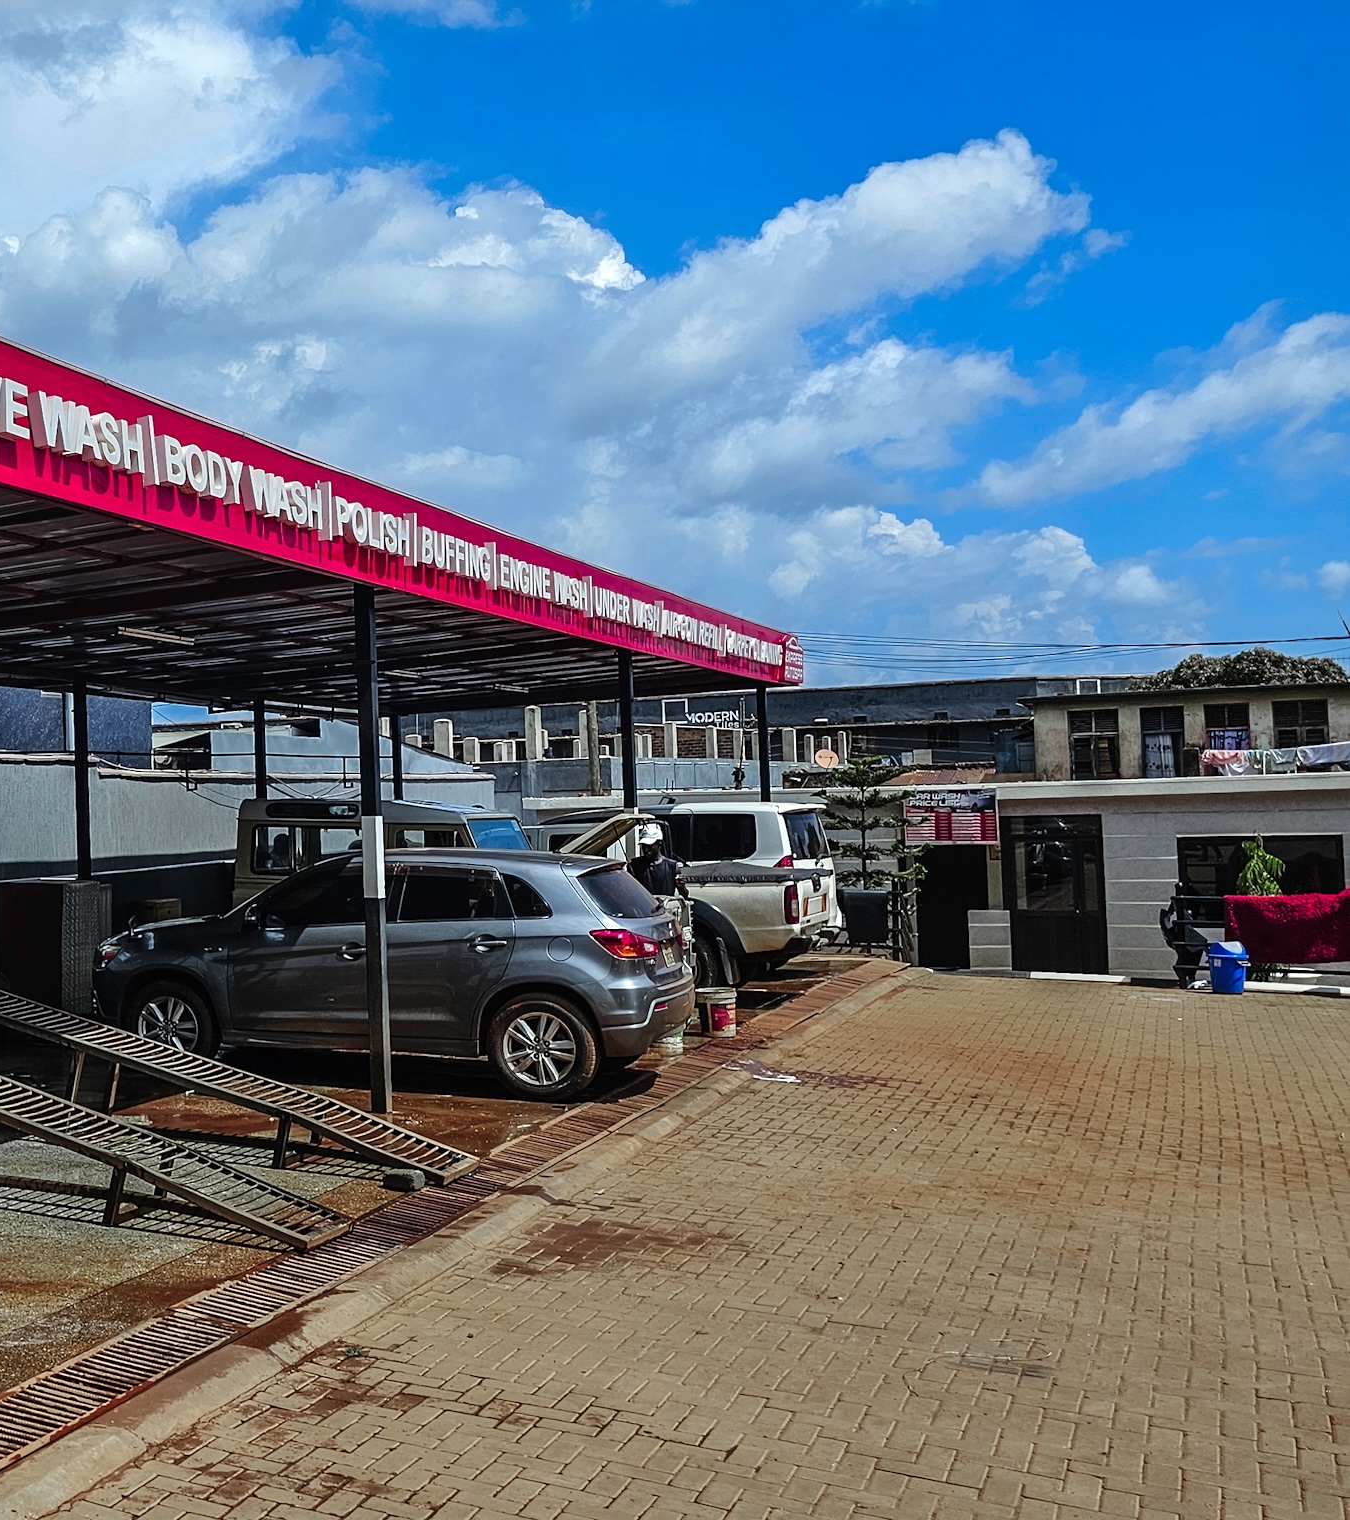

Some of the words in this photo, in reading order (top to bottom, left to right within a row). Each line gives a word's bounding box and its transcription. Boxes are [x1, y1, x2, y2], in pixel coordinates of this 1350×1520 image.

[30, 390, 145, 474] WASH
[156, 434, 244, 505] BODY
[243, 464, 323, 530] WASH
[332, 495, 411, 557] POLISH
[417, 525, 492, 582] BUFFING
[498, 553, 551, 599] ENGINE
[551, 570, 588, 611] WASH
[593, 586, 631, 624] UNDER
[631, 598, 660, 633] WASH
[698, 620, 723, 651] REFILL
[725, 628, 752, 659] CARPET
[685, 710, 739, 724] MODERN
[932, 792, 961, 800] WASH
